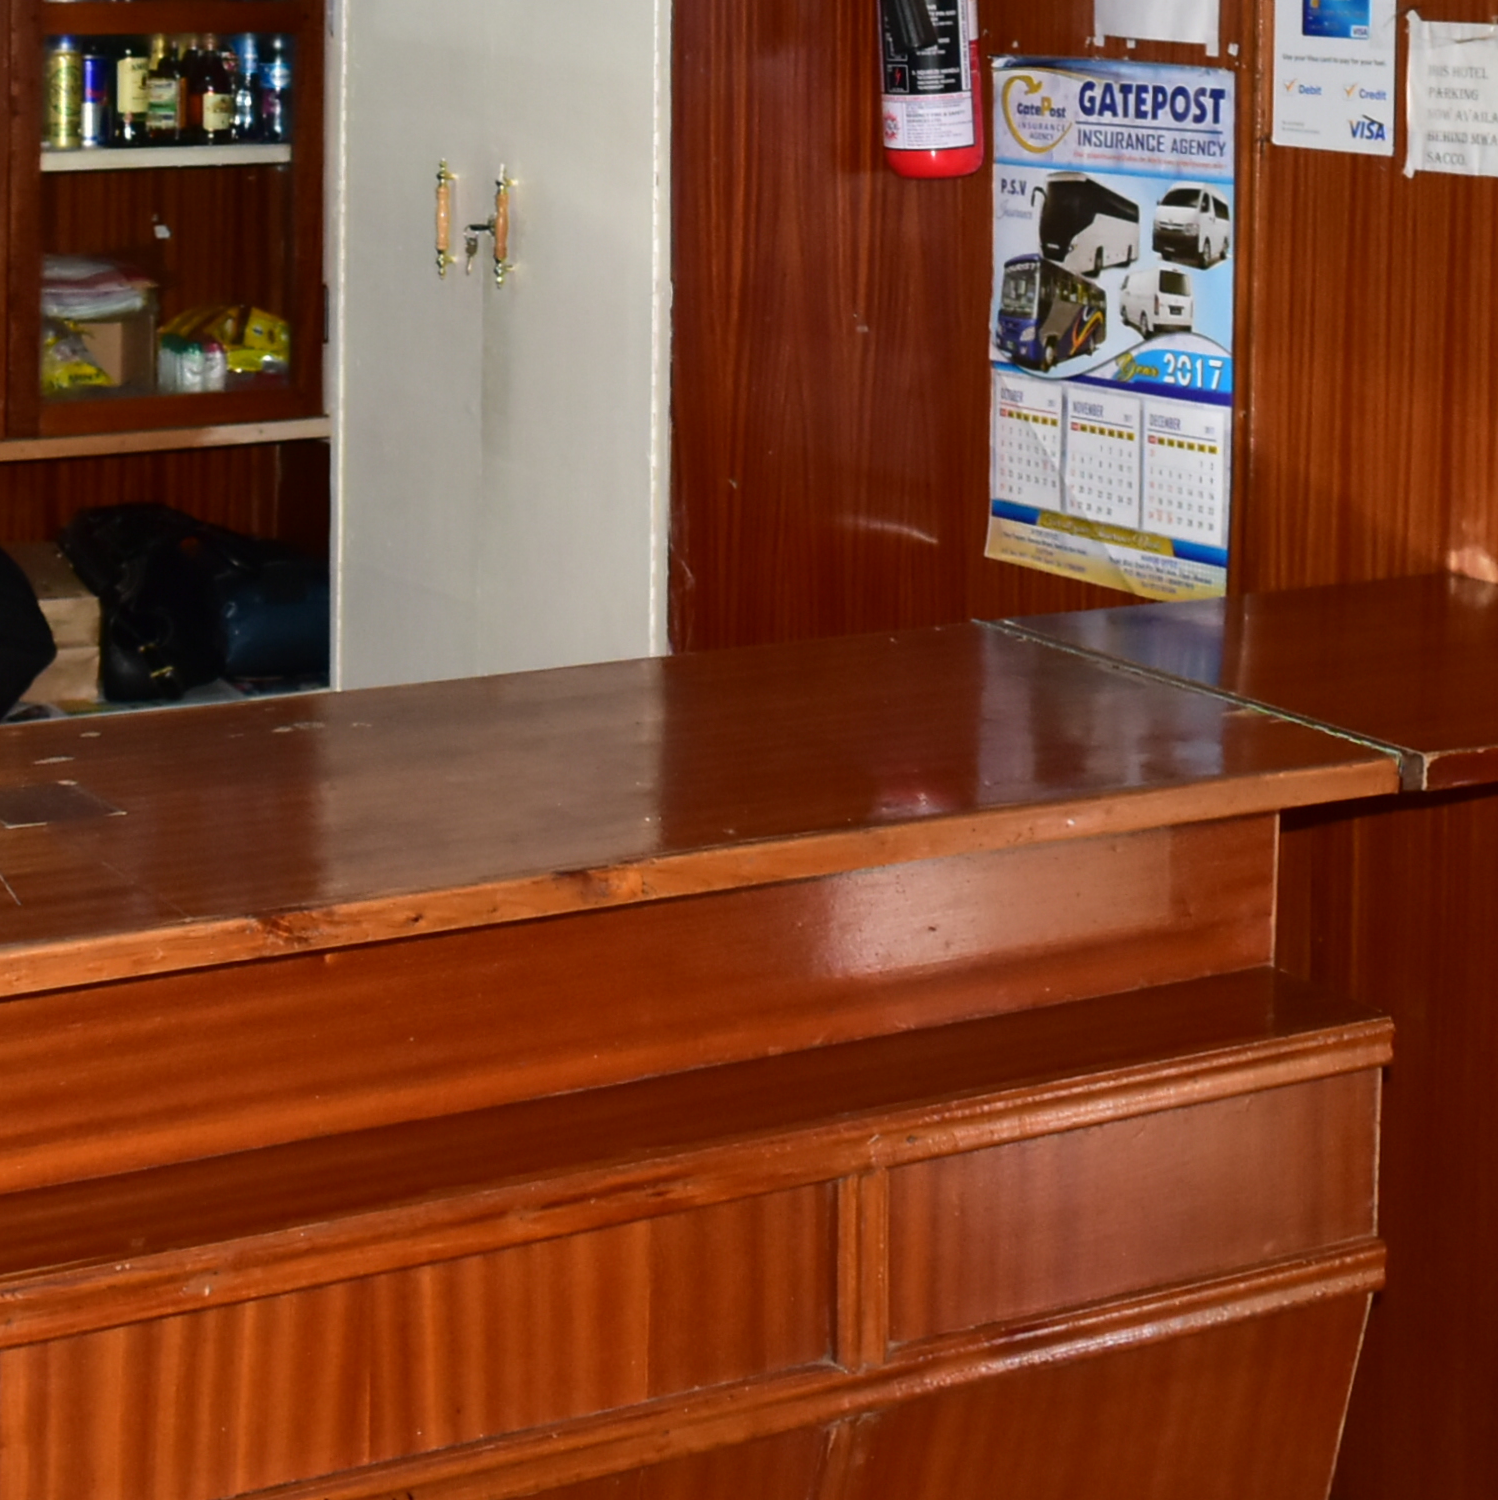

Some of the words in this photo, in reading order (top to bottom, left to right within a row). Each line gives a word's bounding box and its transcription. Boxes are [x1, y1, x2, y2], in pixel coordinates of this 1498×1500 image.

[1453, 66, 1489, 80] HOTEL
[1298, 84, 1322, 96] Debit
[1359, 88, 1387, 101] Credit
[1428, 87, 1479, 100] PARKING
[1078, 81, 1226, 124] GATEPOST
[1018, 121, 1065, 131] INSURANCE
[1349, 119, 1386, 141] VISA
[1030, 132, 1053, 140] AGENCY
[1078, 128, 1165, 152] INSURANCE
[1170, 137, 1226, 157] AGENCY
[1163, 353, 1223, 390] 2017
[1073, 401, 1104, 417] NOVEMBER
[1150, 414, 1181, 431] DECEMBER
